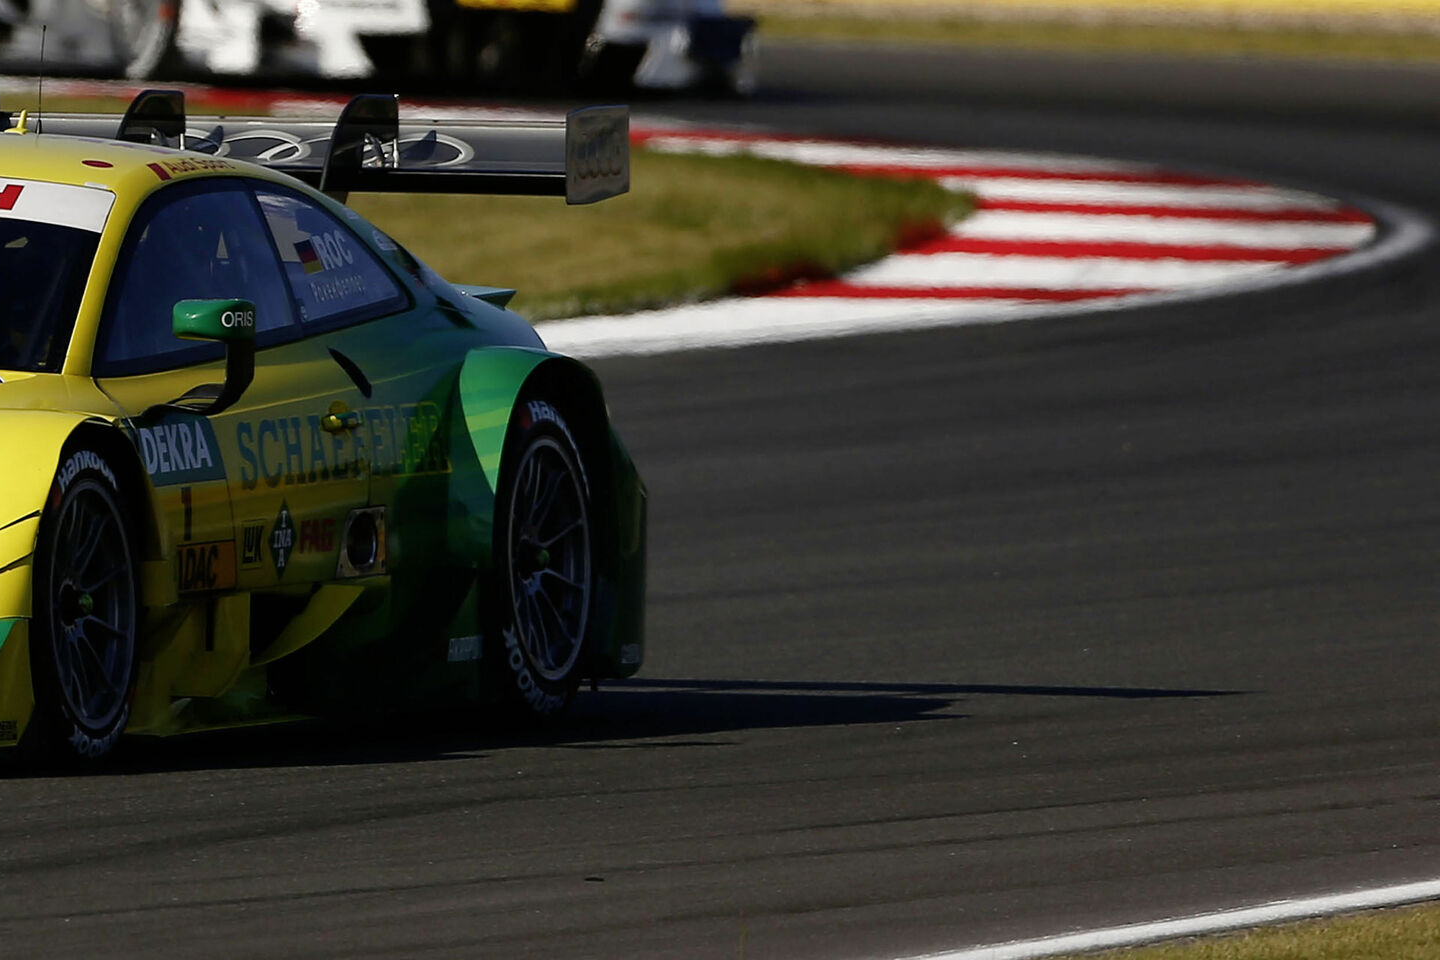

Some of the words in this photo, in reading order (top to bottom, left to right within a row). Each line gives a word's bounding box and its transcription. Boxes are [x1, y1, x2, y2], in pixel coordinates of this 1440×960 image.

[312, 229, 354, 271] ROC
[220, 310, 255, 329] ORIS
[139, 420, 214, 475] DEKRA
[299, 518, 337, 554] FAG
